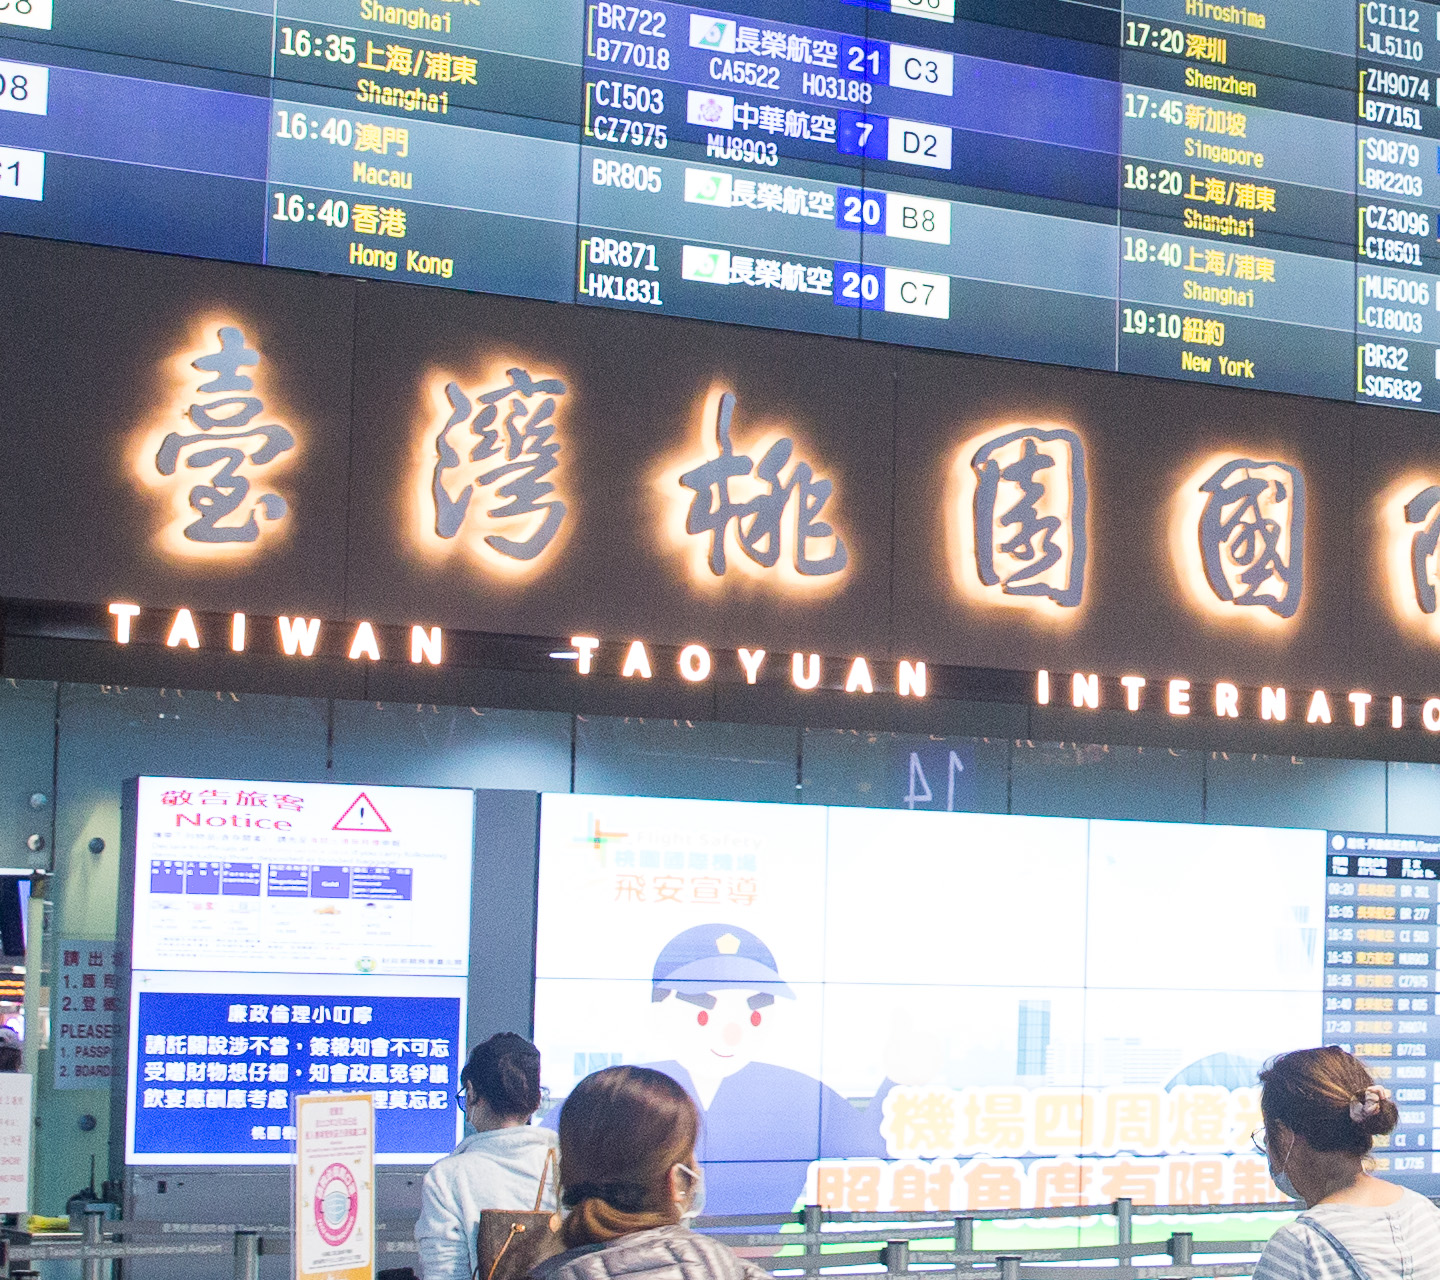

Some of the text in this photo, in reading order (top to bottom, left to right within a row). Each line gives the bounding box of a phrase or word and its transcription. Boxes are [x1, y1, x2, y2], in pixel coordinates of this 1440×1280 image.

[1124, 93, 1247, 138] 17:45 新加坡
[277, 111, 409, 158] 16:40 澳門
[1184, 136, 1264, 169] Singapore
[352, 161, 412, 190] Macau
[592, 158, 935, 234] BR805 B8
[273, 192, 407, 239] 16:40 香港
[349, 242, 454, 278] Hong Kong
[589, 237, 935, 307] BR871 C7
[1122, 308, 1224, 347] 19:10 紐約
[1181, 351, 1254, 379] New York
[109, 603, 443, 665] TAIWAN
[571, 637, 928, 697] TAOYUAN
[161, 790, 304, 812] 敬告旅客
[175, 813, 292, 831] Notice
[614, 874, 758, 906] 飛安宣導
